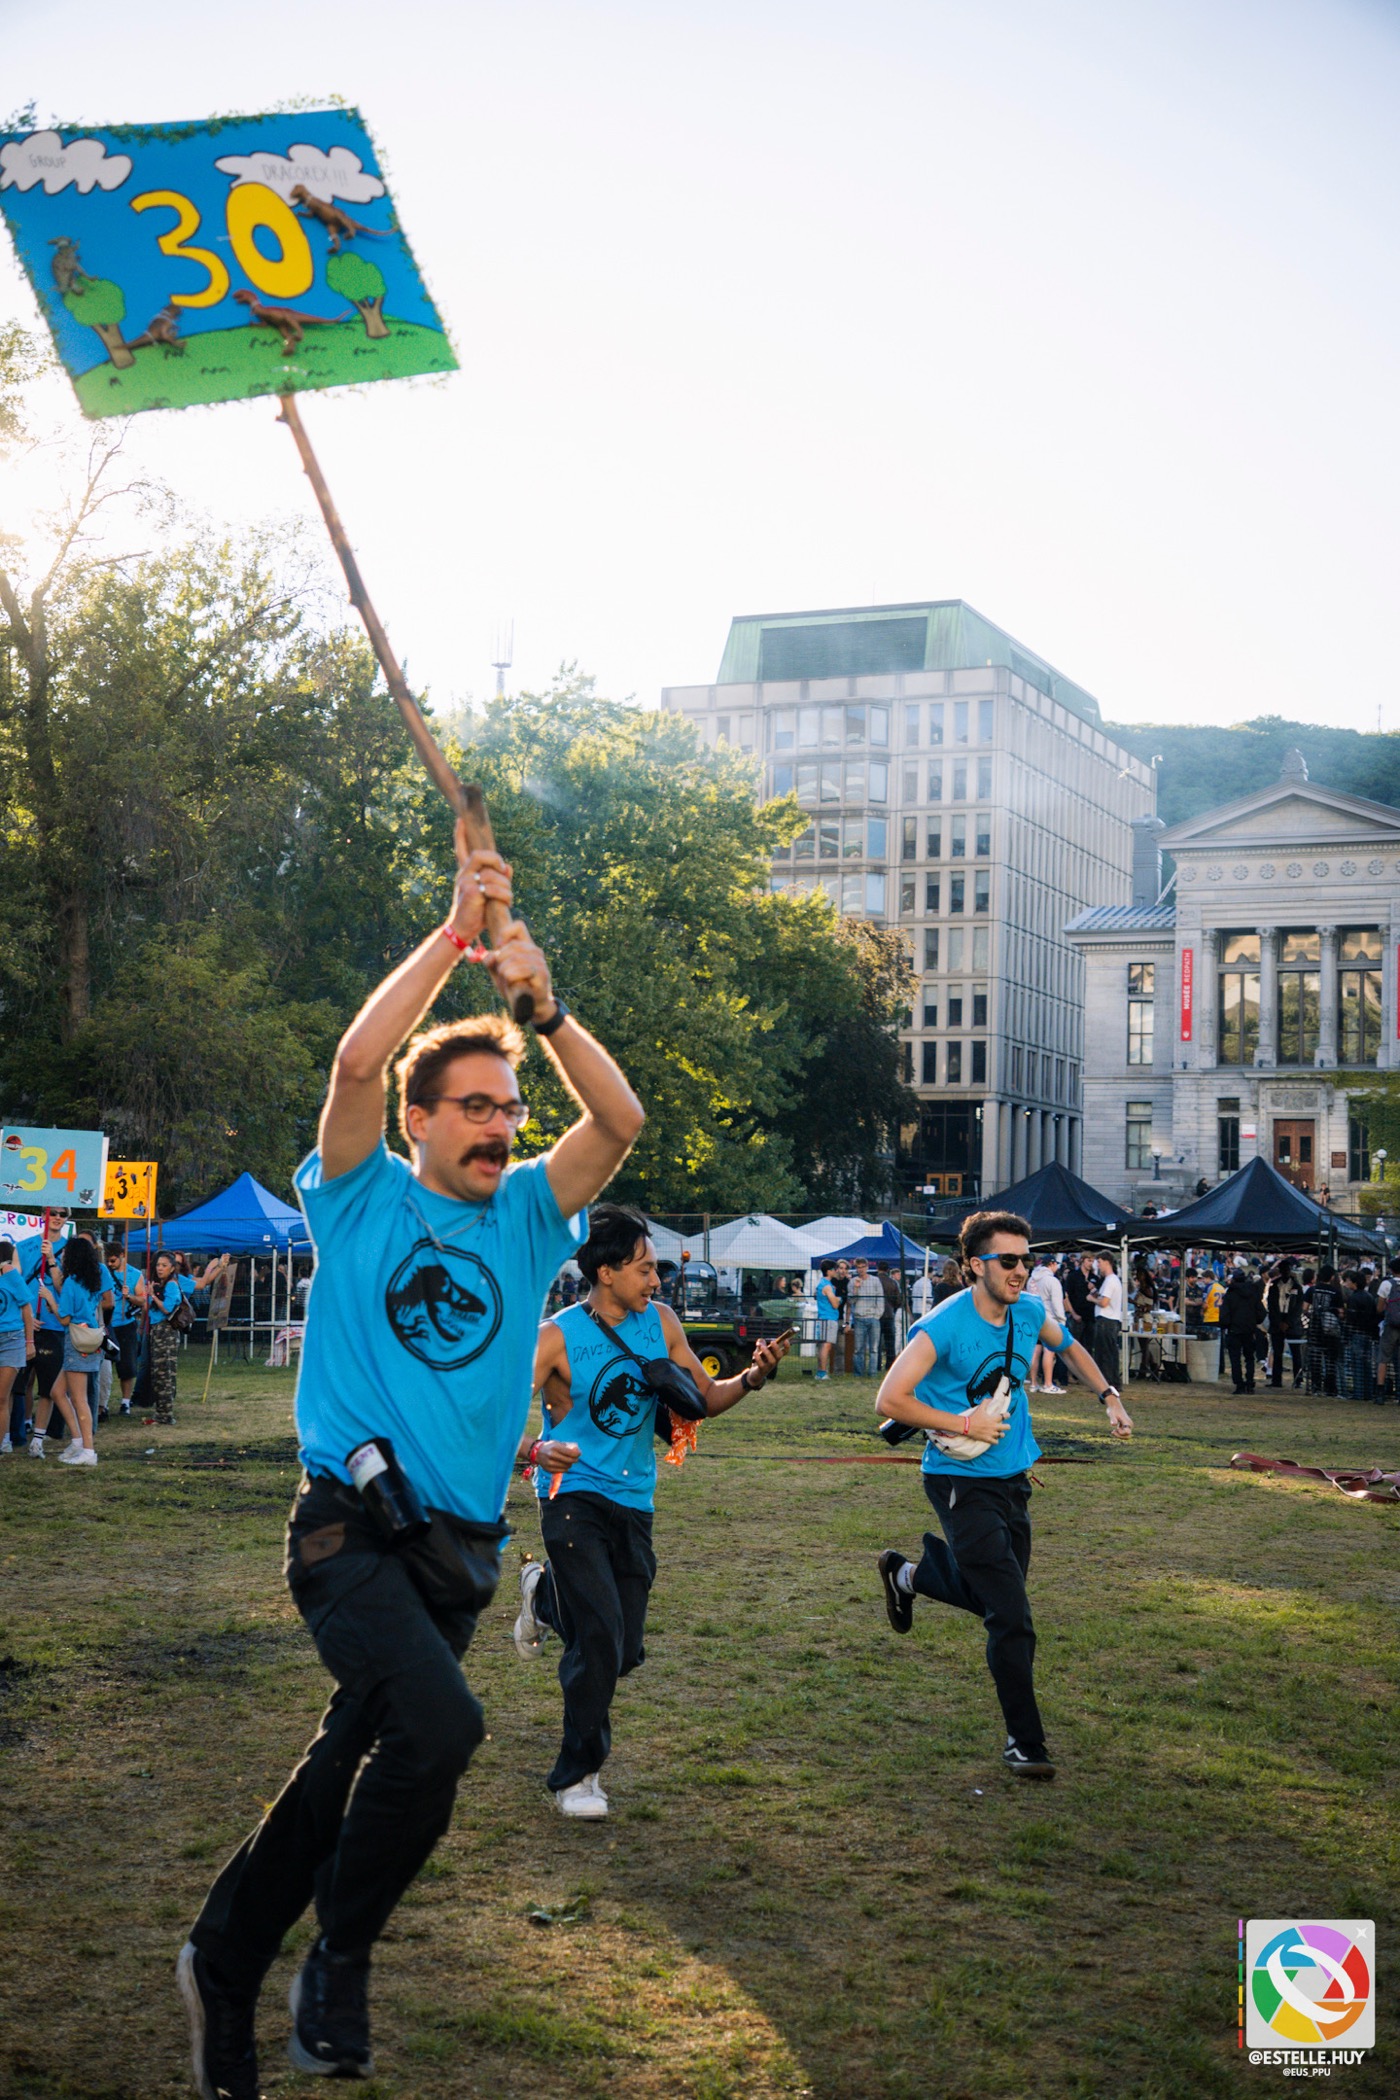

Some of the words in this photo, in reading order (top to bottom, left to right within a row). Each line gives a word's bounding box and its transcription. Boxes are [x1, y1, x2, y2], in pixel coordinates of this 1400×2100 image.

[29, 153, 67, 168] GROUP
[128, 181, 315, 310] 30
[1183, 952, 1191, 983] REDPATH
[18, 1146, 78, 1193] 34
[634, 1322, 662, 1349] 30
[1013, 1321, 1033, 1341] 30
[572, 1343, 613, 1364] DAVID
